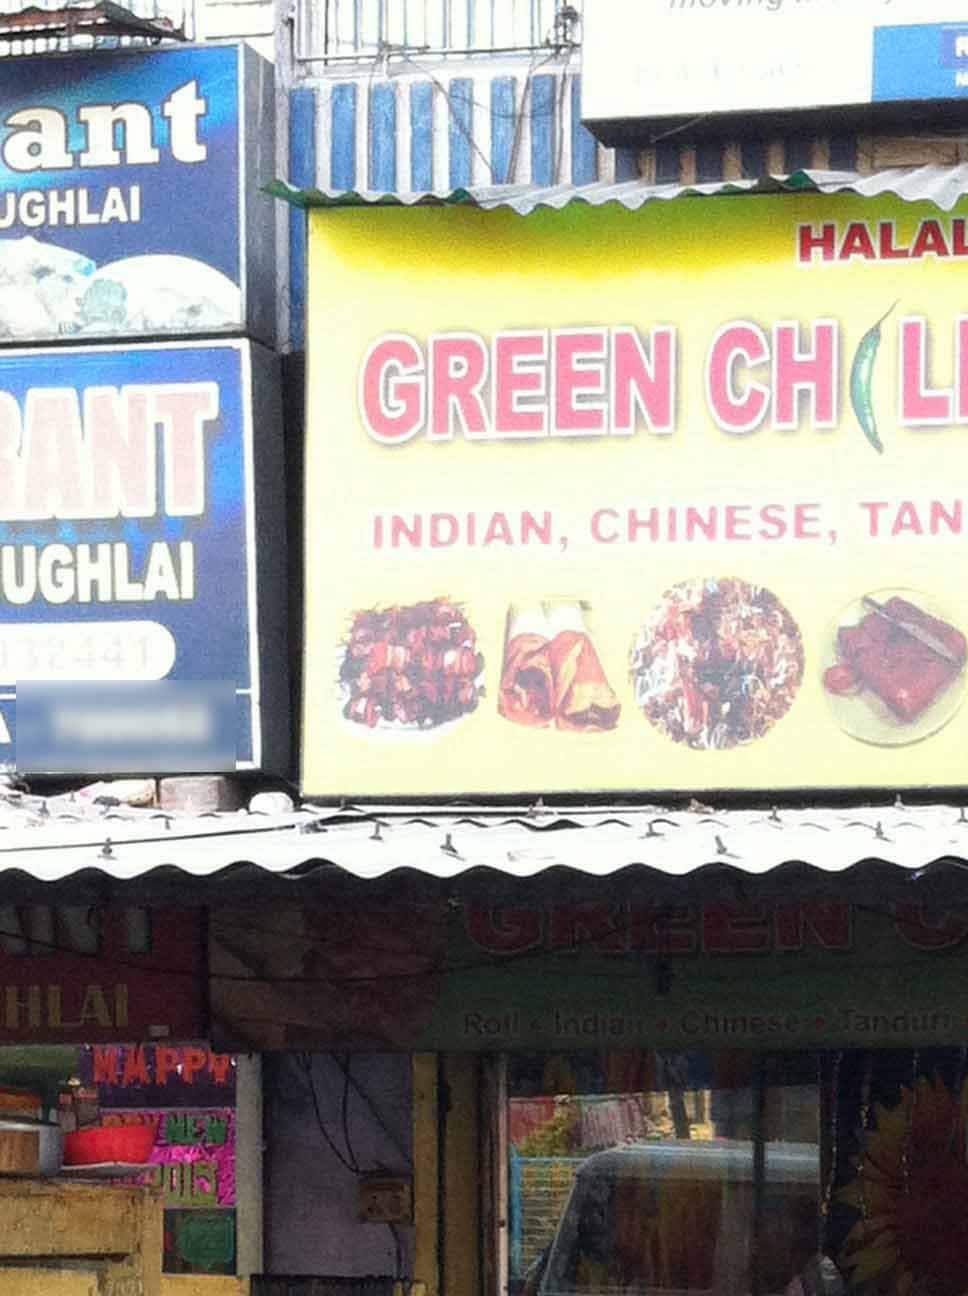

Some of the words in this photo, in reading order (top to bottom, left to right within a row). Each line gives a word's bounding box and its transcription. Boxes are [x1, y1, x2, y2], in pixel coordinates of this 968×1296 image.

[358, 324, 677, 444] GREEN
[373, 511, 569, 552] INDIAN,
[590, 503, 839, 546] CHINESE,
